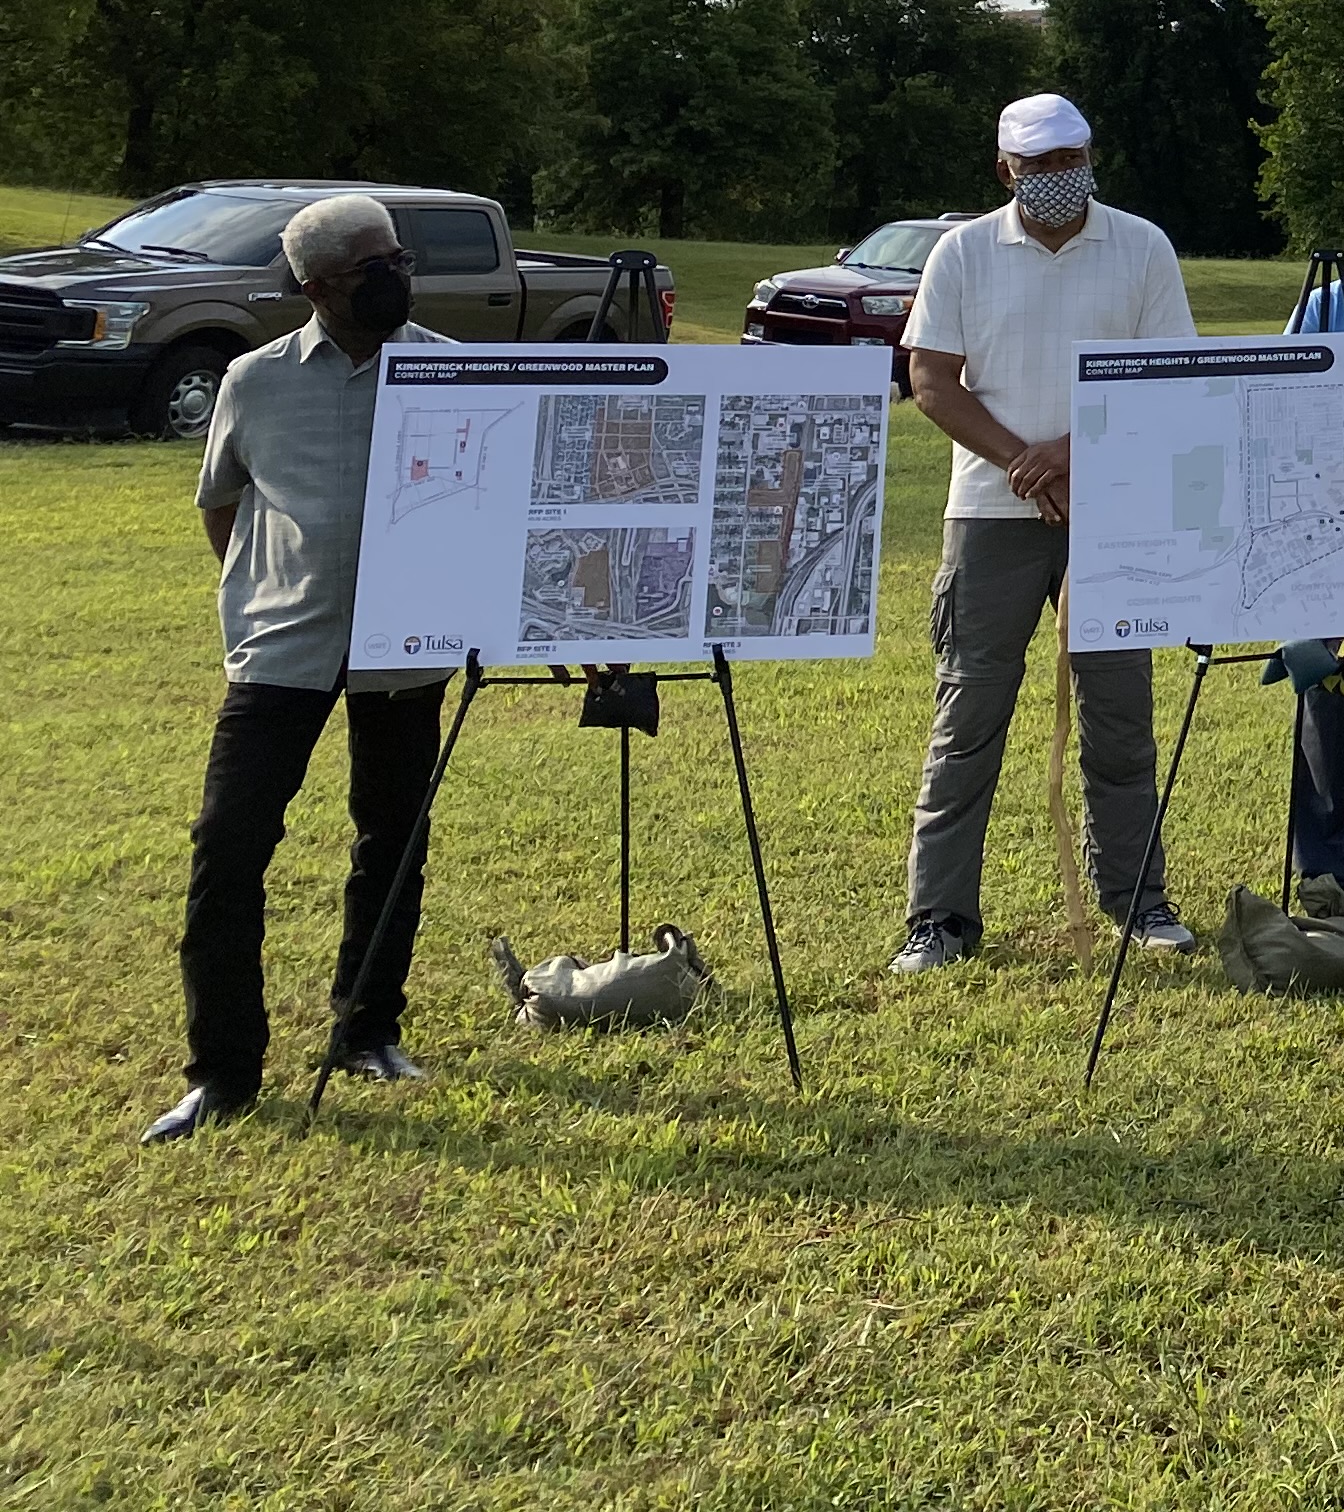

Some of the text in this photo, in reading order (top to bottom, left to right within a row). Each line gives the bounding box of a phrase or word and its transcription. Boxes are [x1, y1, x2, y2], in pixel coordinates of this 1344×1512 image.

[395, 363, 463, 371] KIRKPATRICK
[465, 363, 510, 371] HEIGHTS
[518, 363, 583, 371] GREENWOOD
[585, 363, 626, 371] MASTER
[627, 363, 654, 371] PLAN
[1086, 358, 1147, 368] KIRKPATRICK
[1149, 356, 1190, 366] HEIGHTS
[1197, 354, 1256, 364] GREENWOOD
[1258, 353, 1295, 361] MASTER
[1296, 352, 1322, 360] PLAN
[1132, 618, 1168, 633] Tulsa
[424, 634, 463, 650] Tulsa
